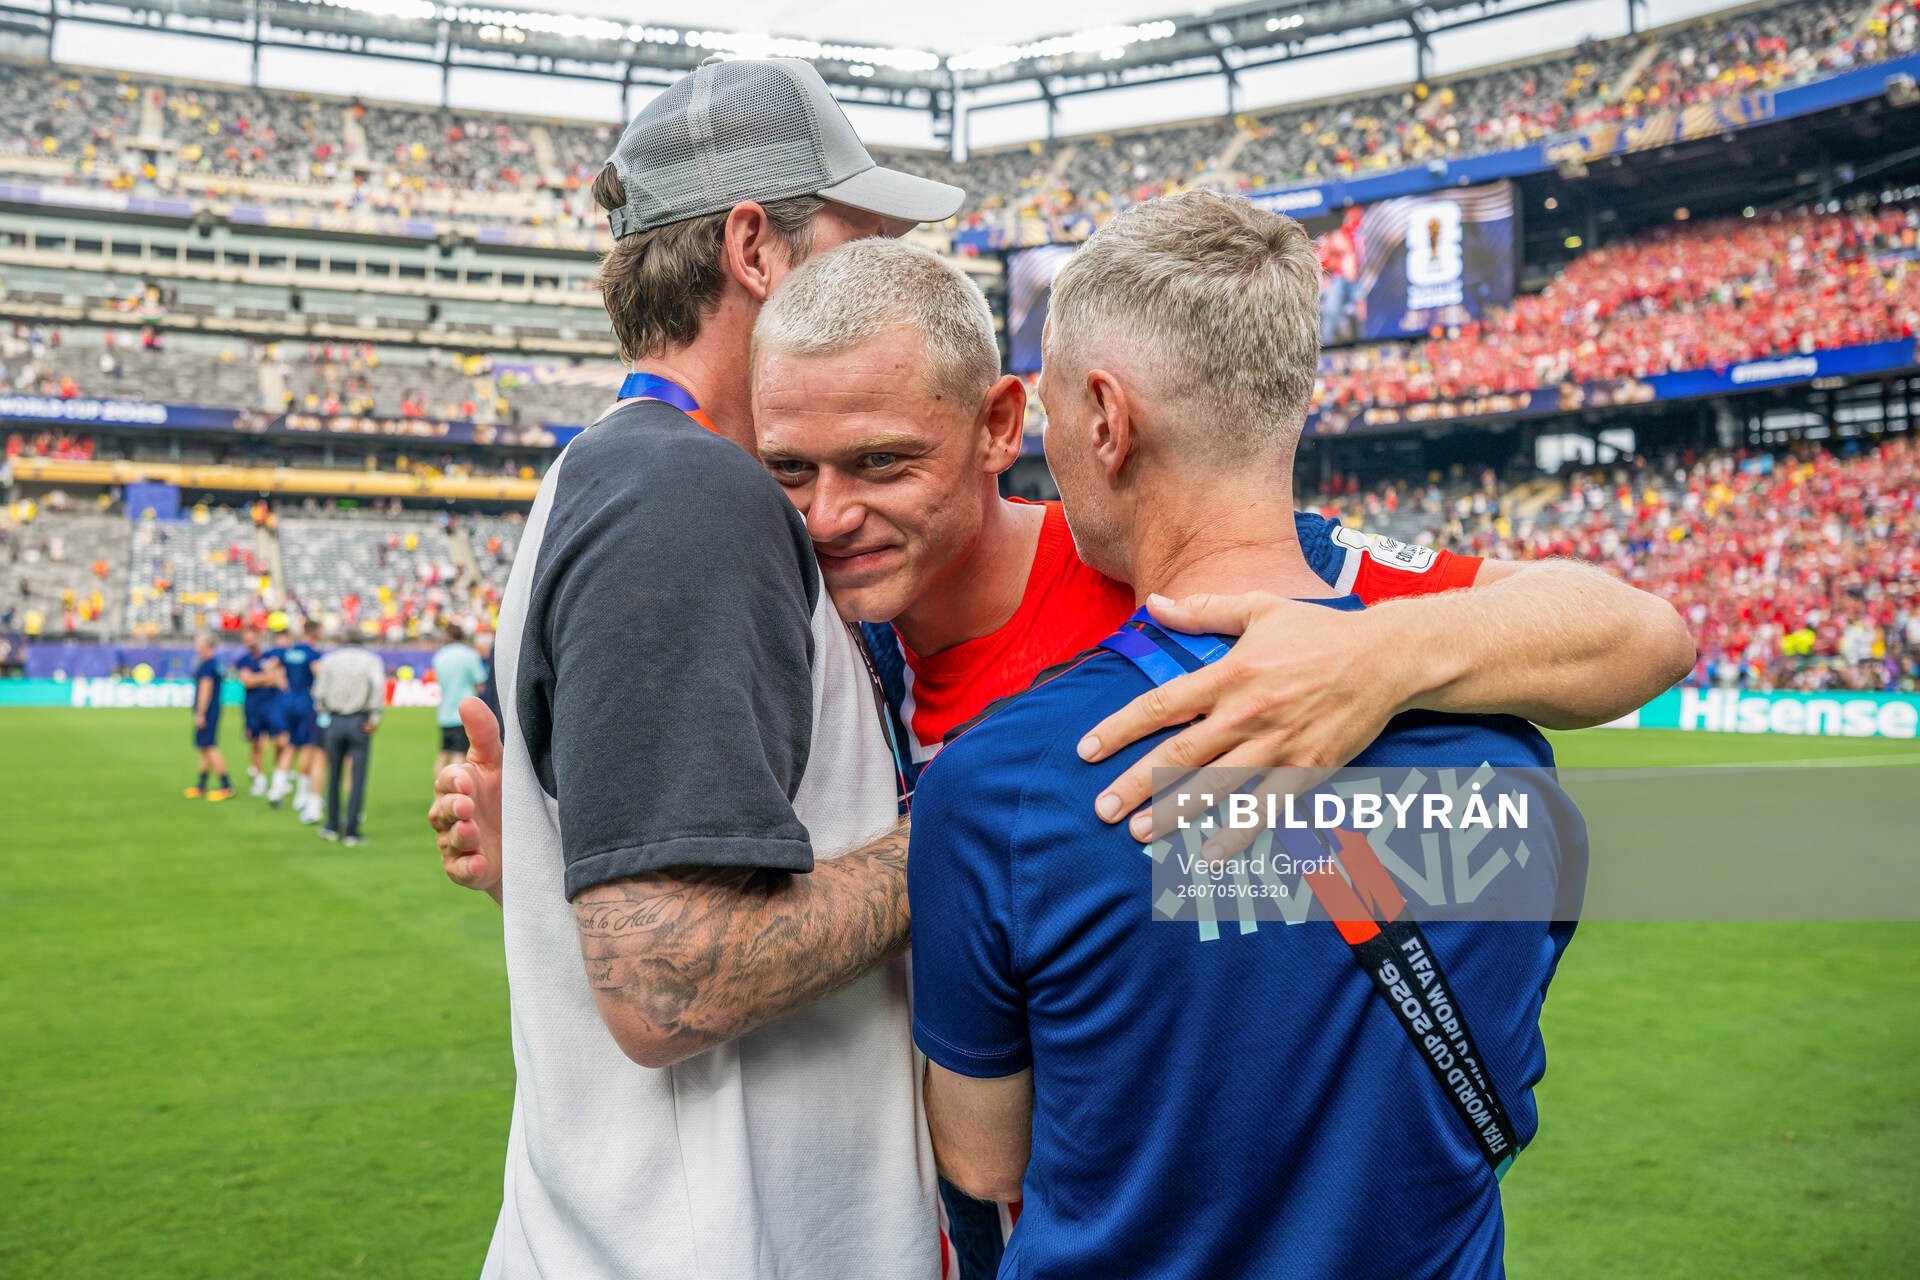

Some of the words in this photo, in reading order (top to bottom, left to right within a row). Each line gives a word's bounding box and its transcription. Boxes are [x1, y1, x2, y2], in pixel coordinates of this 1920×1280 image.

[72, 676, 197, 708] Hisen
[1679, 687, 1918, 738] Hisense
[1401, 936, 1435, 989] FIFA
[1423, 1034, 1455, 1070] CUP
[1447, 1067, 1490, 1128] WORLD
[1482, 1122, 1507, 1154] FIFA
